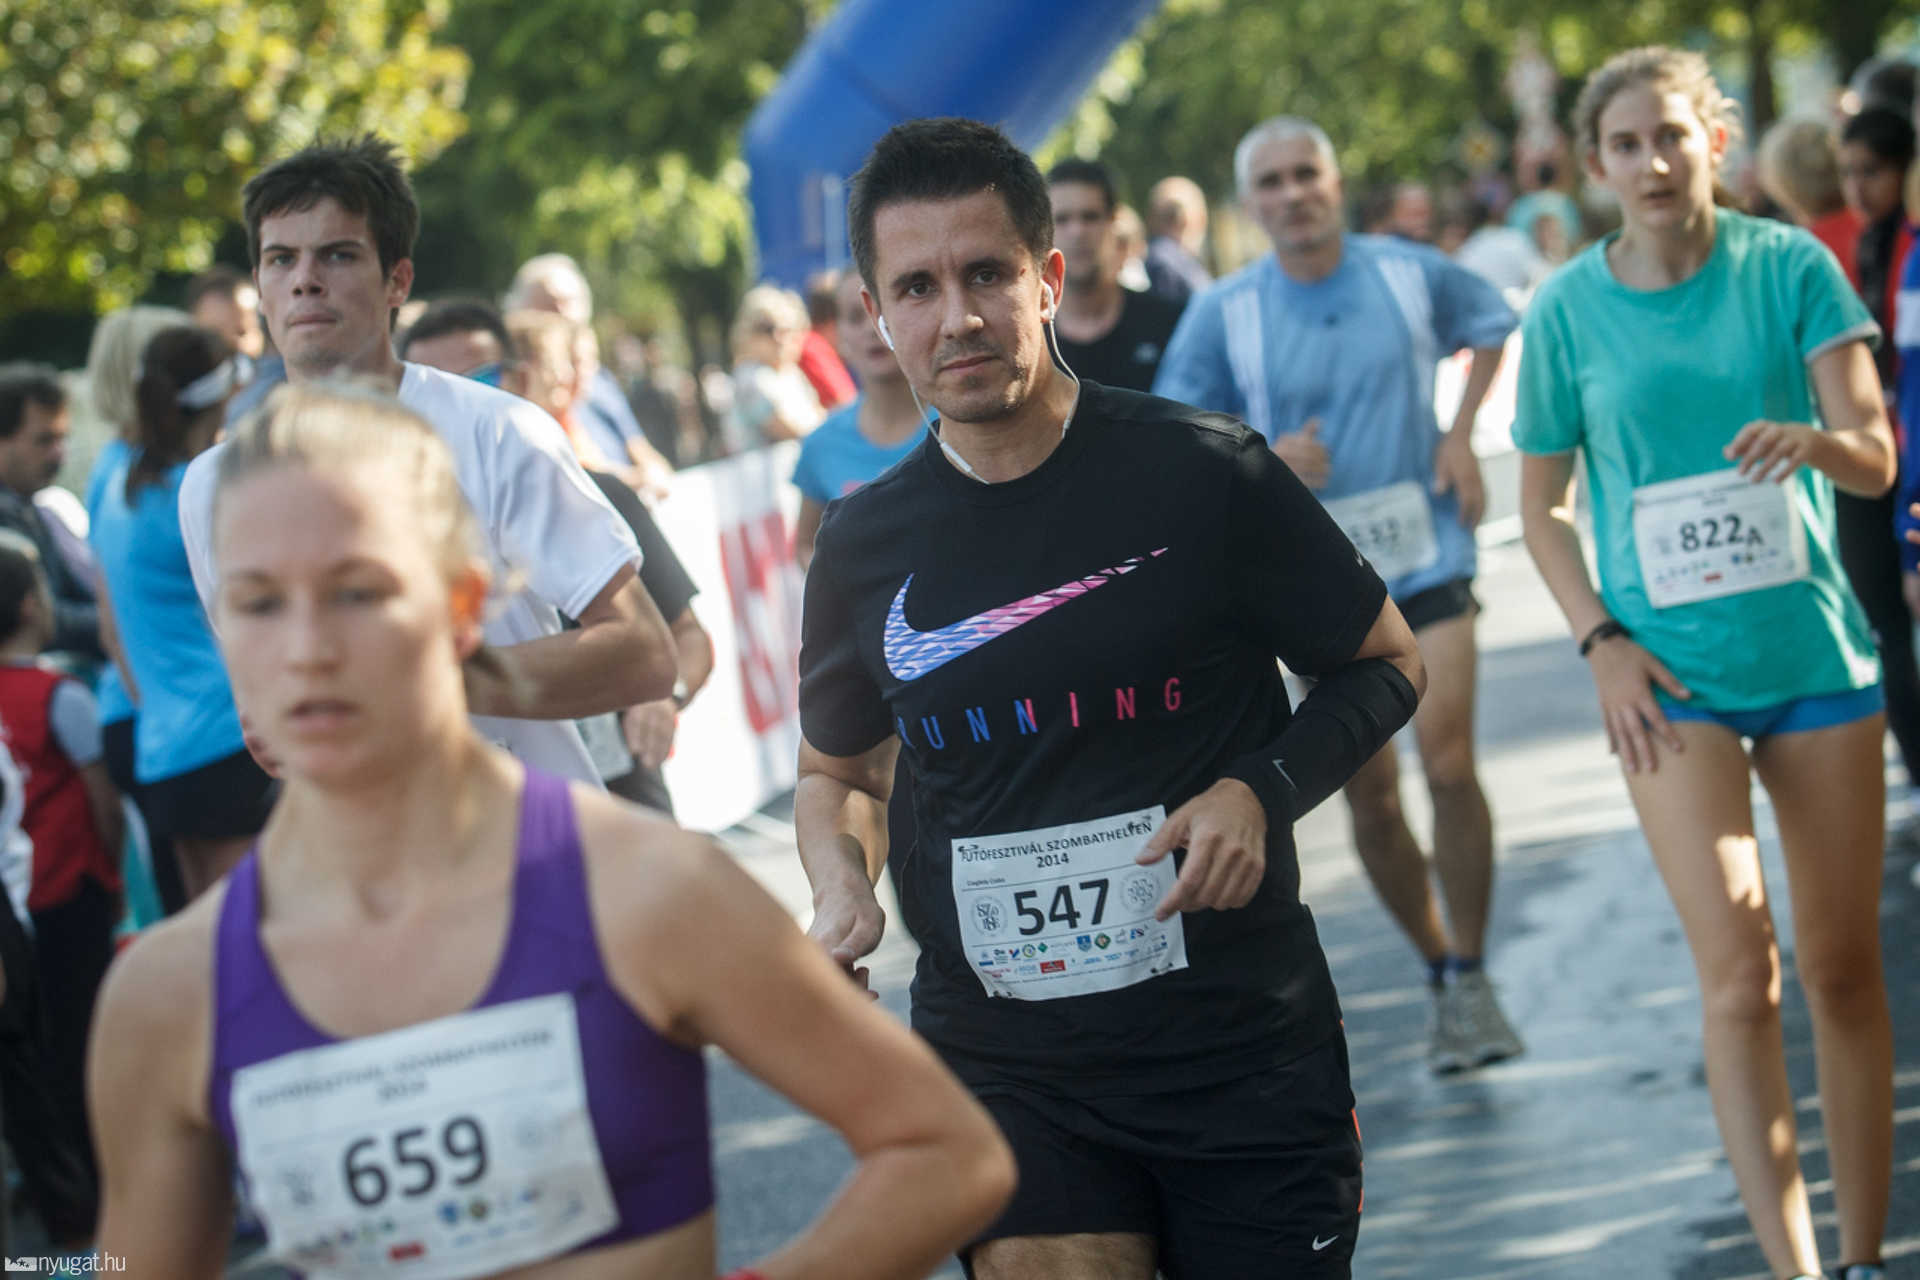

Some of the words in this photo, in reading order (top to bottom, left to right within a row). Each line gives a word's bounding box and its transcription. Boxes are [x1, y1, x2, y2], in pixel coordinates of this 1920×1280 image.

[1036, 852, 1070, 869] 2014
[1014, 878, 1110, 936] 547
[343, 1114, 490, 1207] 659
